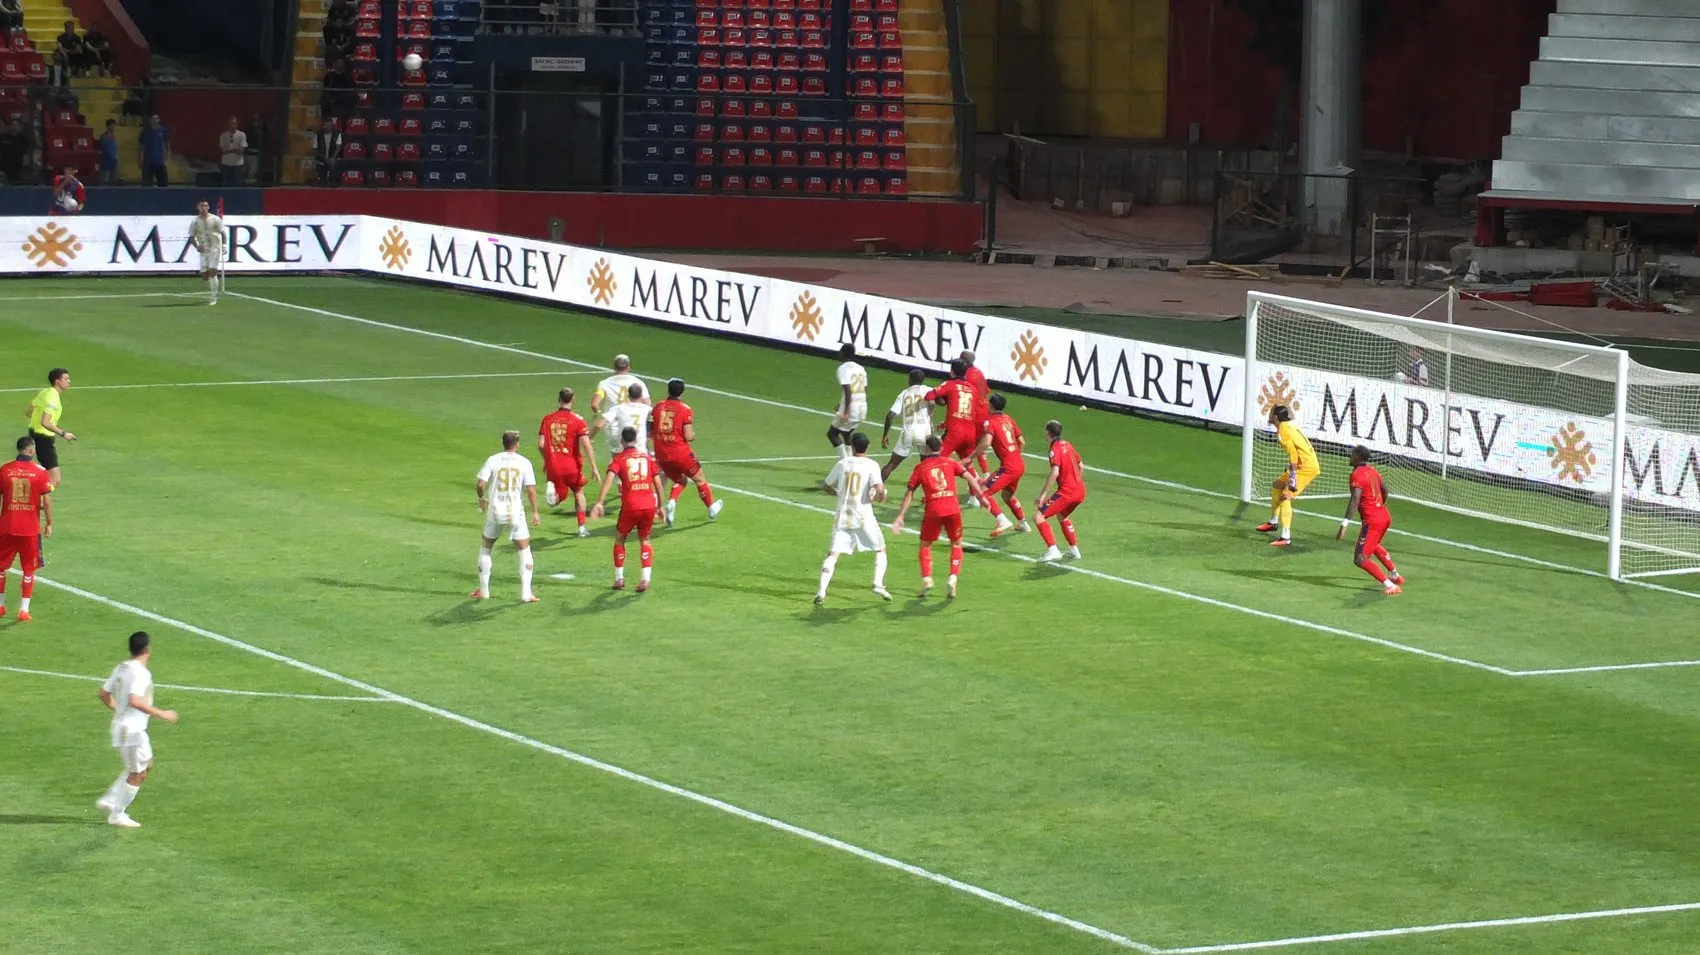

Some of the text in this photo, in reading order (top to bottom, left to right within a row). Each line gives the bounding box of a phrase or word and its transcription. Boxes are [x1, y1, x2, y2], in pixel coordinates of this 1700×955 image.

[426, 233, 567, 292] MAREV
[630, 266, 762, 327] MAREV
[837, 300, 985, 364] MAREV
[1063, 340, 1231, 413] MAREV
[1317, 382, 1505, 463] MAREV
[844, 471, 861, 497] 10
